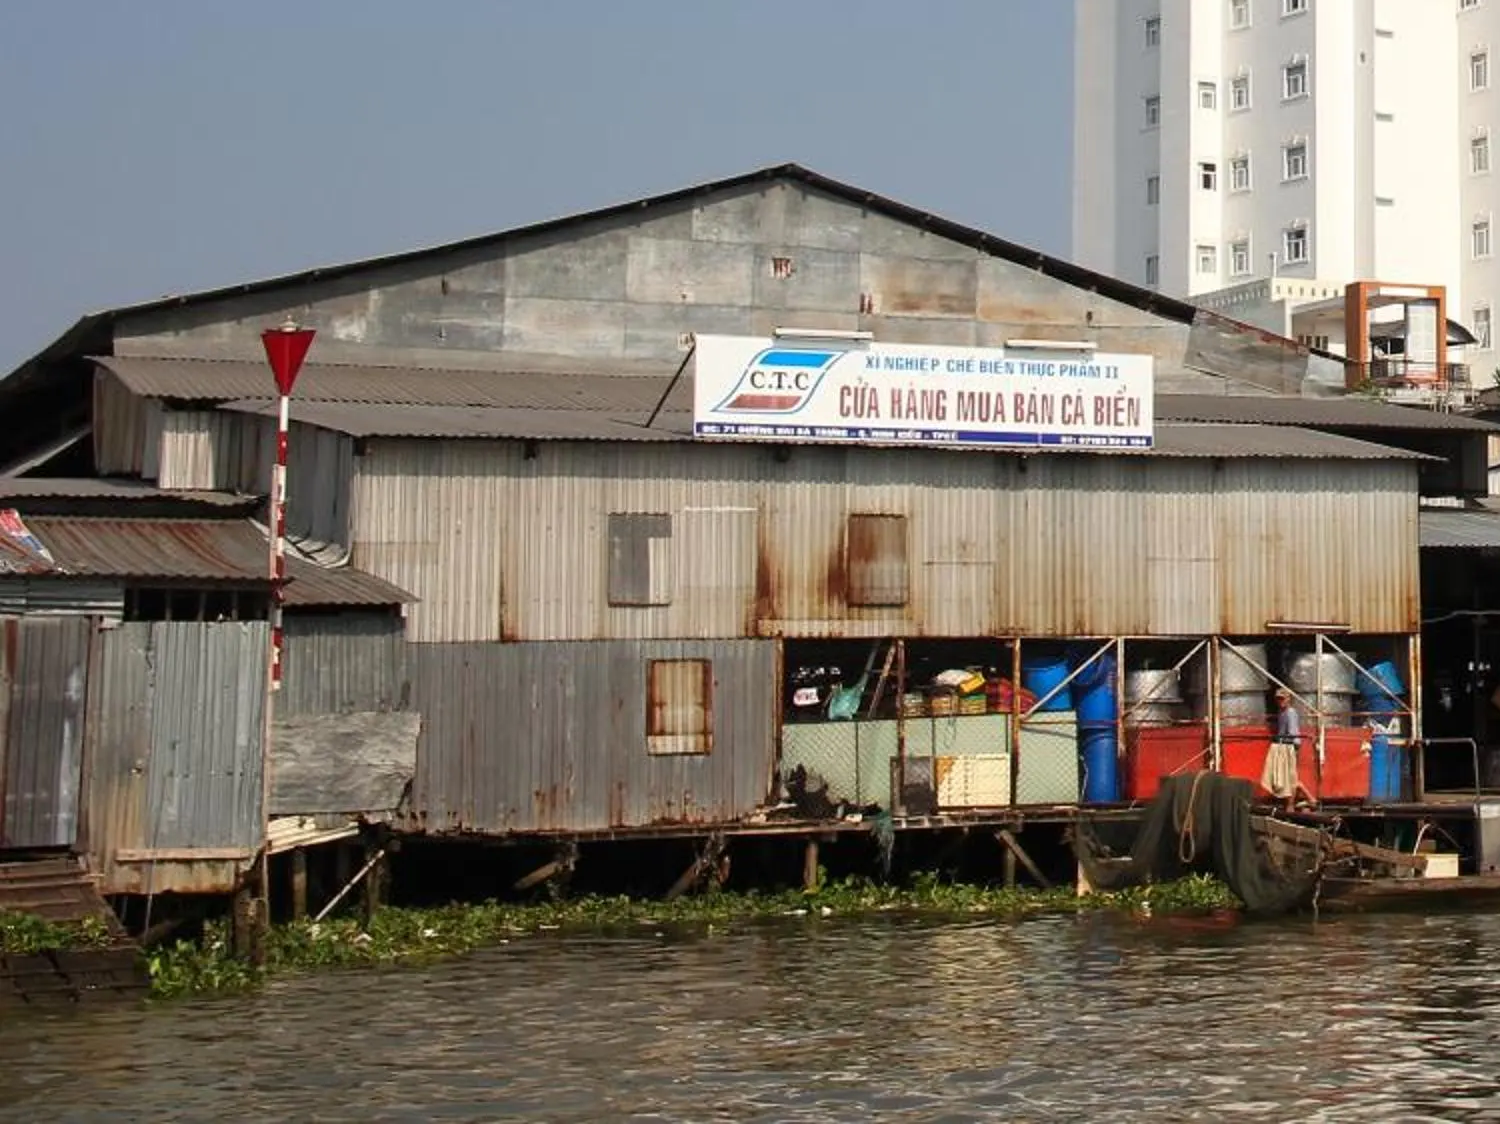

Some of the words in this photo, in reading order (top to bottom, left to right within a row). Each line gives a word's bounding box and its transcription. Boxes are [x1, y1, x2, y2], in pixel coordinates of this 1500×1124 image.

[750, 370, 809, 390] C.T.C
[1105, 366, 1119, 379] II
[839, 376, 880, 418] CỬA
[956, 391, 1006, 423] MUA
